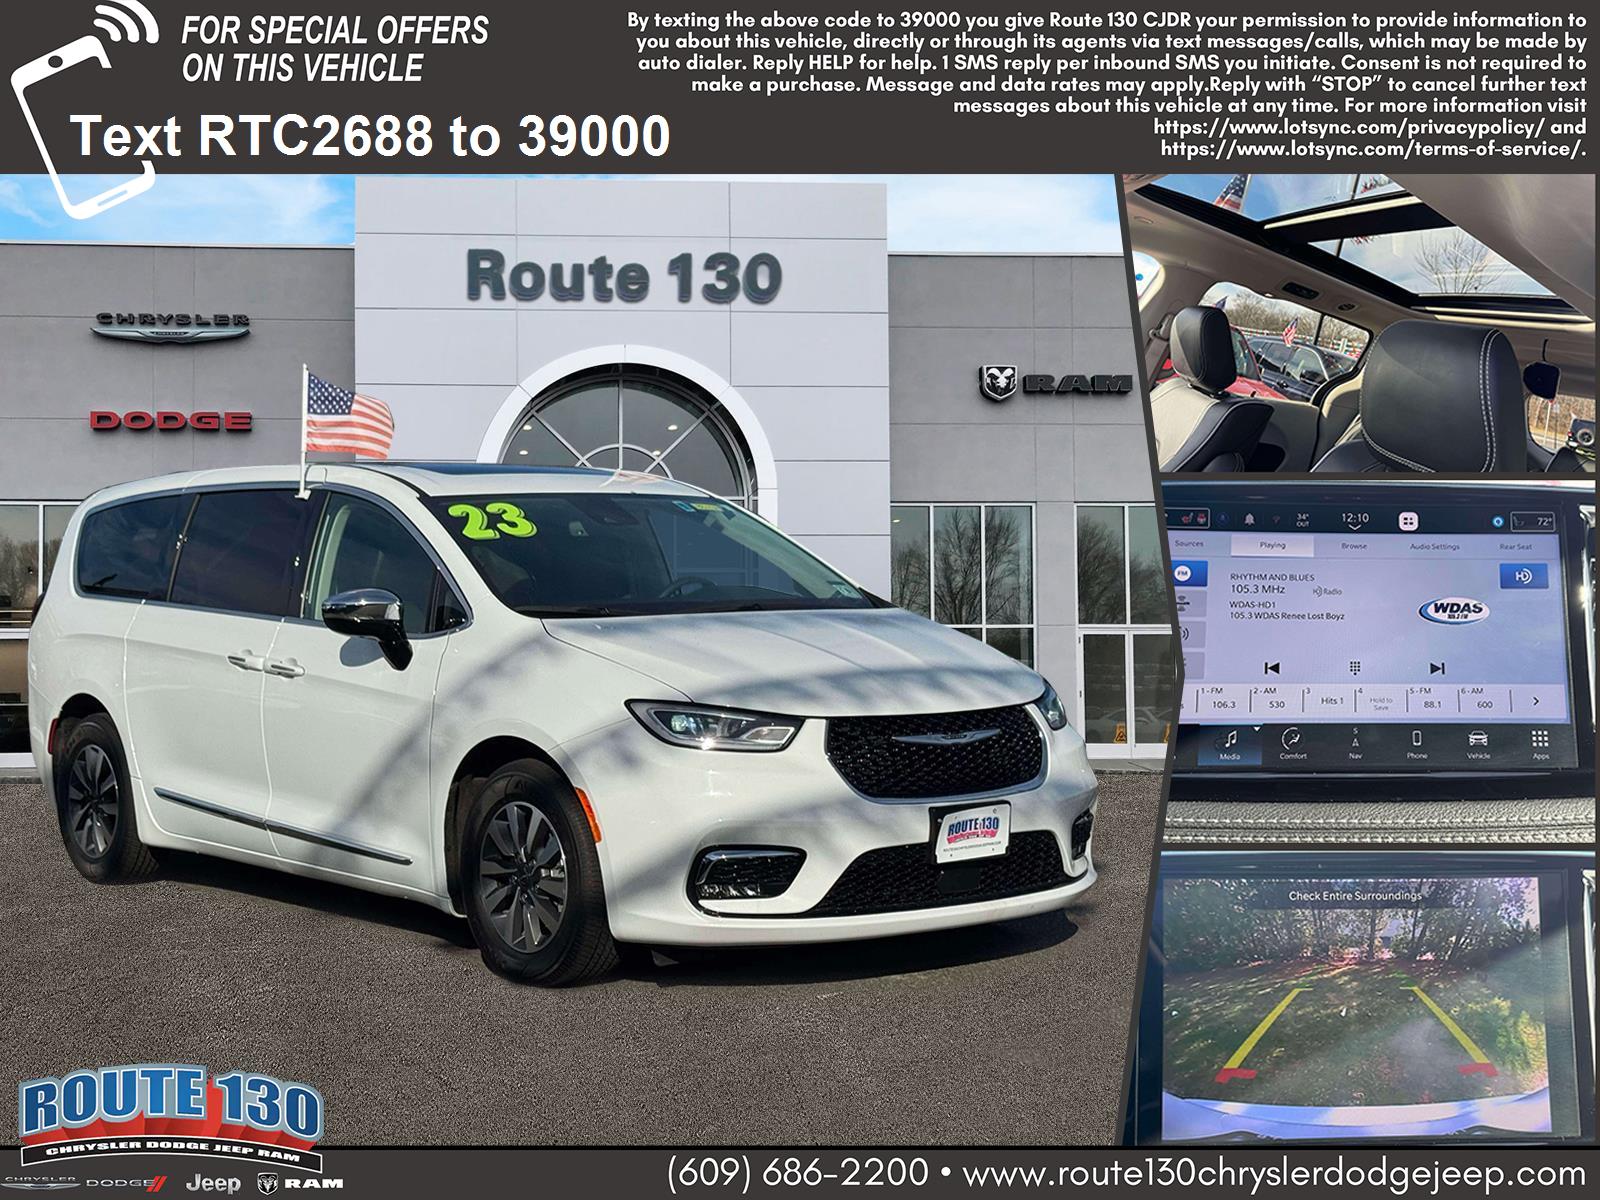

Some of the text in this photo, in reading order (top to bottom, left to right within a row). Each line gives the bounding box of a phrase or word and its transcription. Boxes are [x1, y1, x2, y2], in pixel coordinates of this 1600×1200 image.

[466, 248, 783, 304] Route 130
[95, 312, 250, 327] CHRYSLER
[1022, 374, 1133, 394] RAM
[89, 410, 253, 432] DODGE
[448, 503, 537, 540] 23
[1341, 512, 1370, 524] 12:10
[1174, 540, 1204, 548] Sources
[1259, 541, 1287, 551] Playing
[1341, 542, 1368, 550] Browse
[1410, 542, 1461, 552] Audio Settings
[1499, 543, 1533, 551] Rear Seat
[1230, 573, 1316, 582] RHYTHM AND BLUES
[1230, 584, 1286, 595] 105.3 MHz
[1323, 587, 1343, 596] Radio
[1229, 601, 1276, 609] WDAS-HD1
[1433, 602, 1483, 614] WDAS
[1230, 612, 1345, 622] 105.3 WDAS Renee Lost Boyz
[1419, 687, 1432, 695] FM
[1471, 687, 1484, 695] AM
[1212, 700, 1236, 709] 106.3
[1269, 700, 1285, 709] 530
[1321, 696, 1338, 705] Hits
[1424, 700, 1442, 709] 88.1
[1477, 700, 1493, 709] 600
[1219, 753, 1241, 761] Media
[1279, 752, 1307, 761] Comfort
[1349, 752, 1363, 761] Nav
[1407, 752, 1428, 760] Phone
[1467, 752, 1491, 760] Vehicle
[1532, 753, 1550, 762] Apps
[948, 816, 1000, 836] ROUTE 130
[1288, 890, 1422, 903] Check Entire Surroundings
